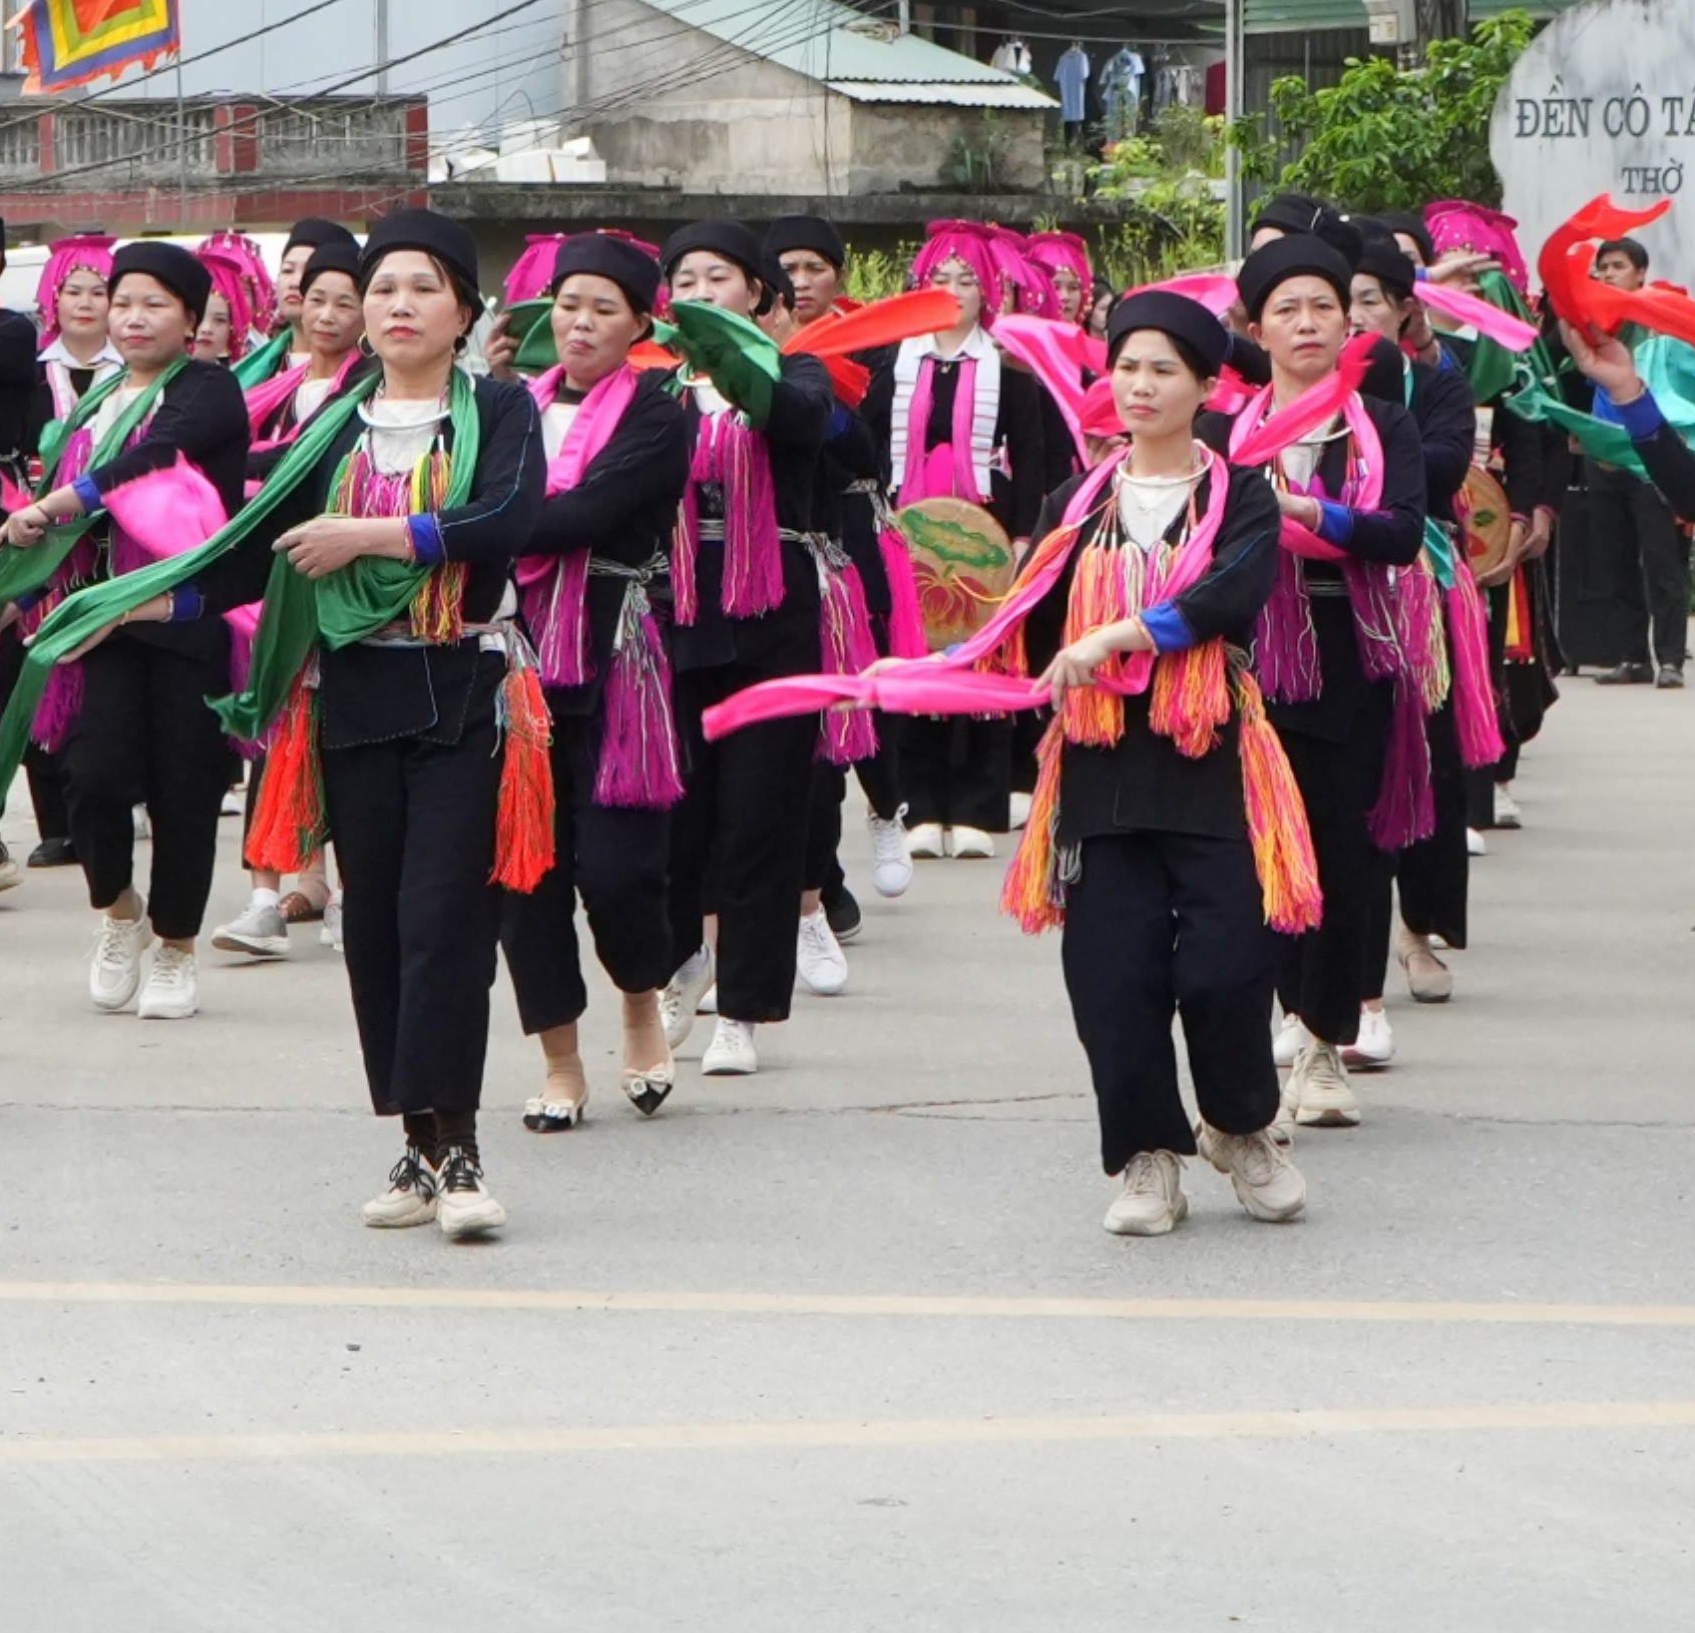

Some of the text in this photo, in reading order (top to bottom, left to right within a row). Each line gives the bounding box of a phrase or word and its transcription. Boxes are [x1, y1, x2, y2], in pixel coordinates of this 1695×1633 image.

[1515, 75, 1593, 138] ĐỀN
[1603, 83, 1650, 136] CÔ
[1622, 158, 1684, 194] THỜ
